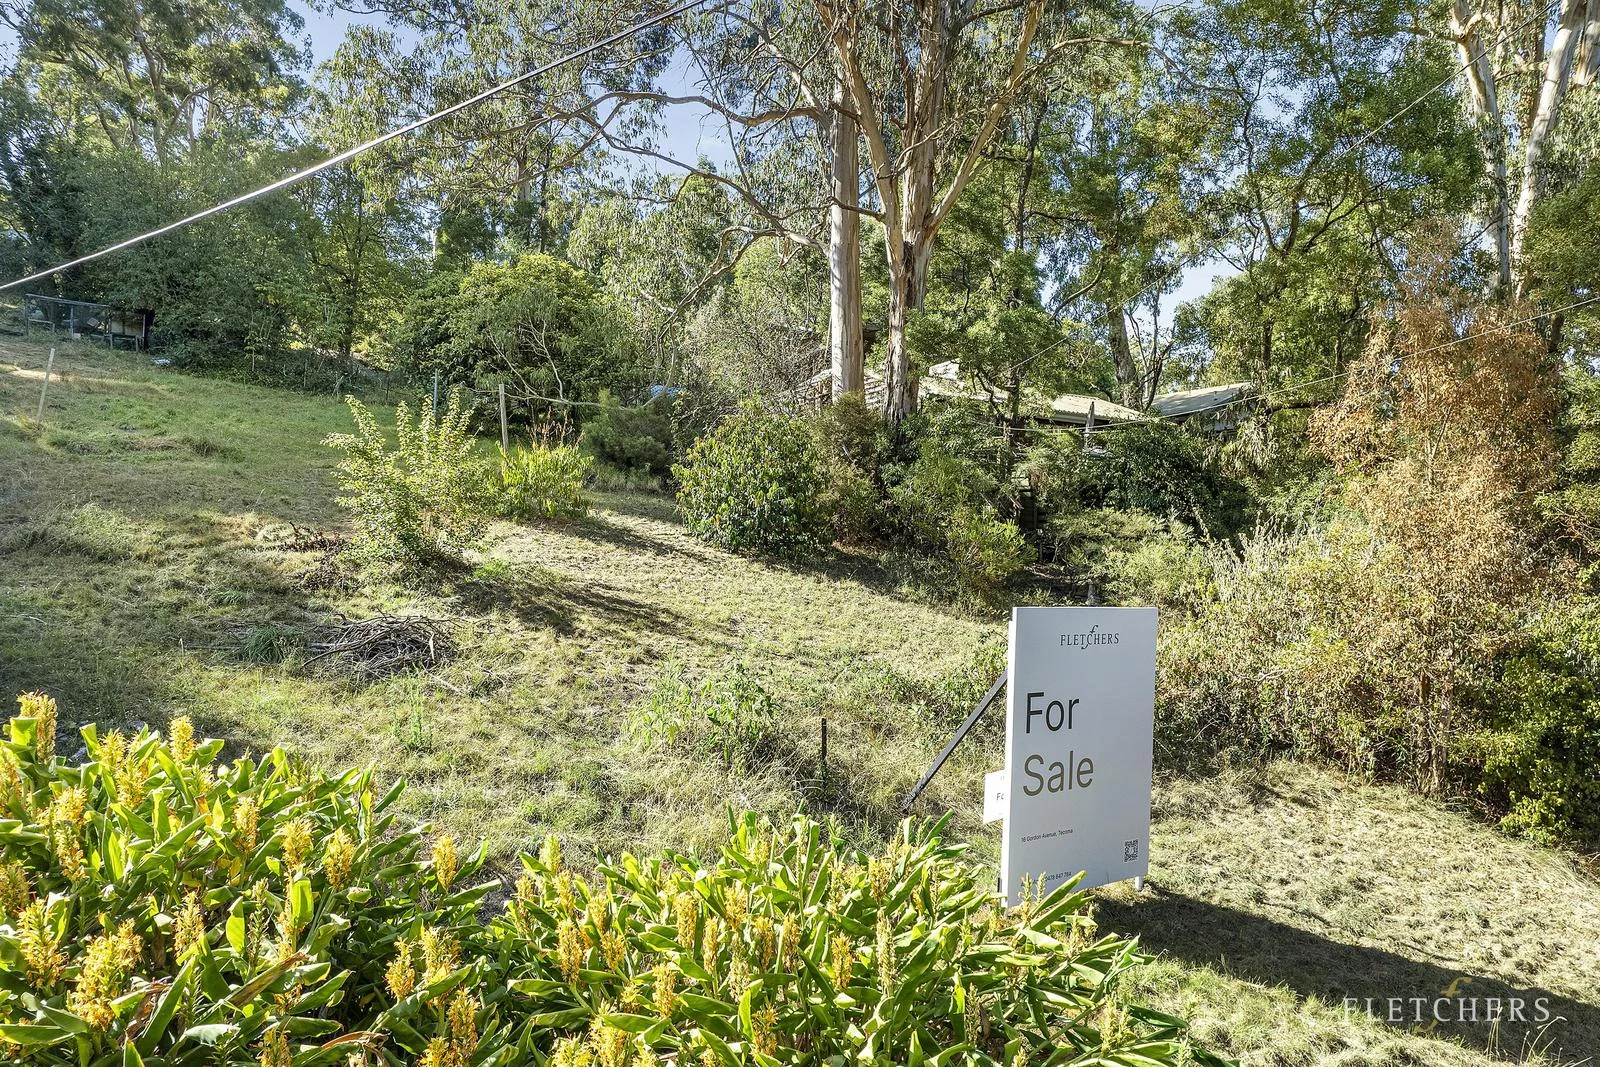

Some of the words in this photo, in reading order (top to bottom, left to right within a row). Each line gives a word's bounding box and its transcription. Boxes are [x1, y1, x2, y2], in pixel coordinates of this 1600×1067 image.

[1060, 632, 1120, 646] FLETCHERS
[1025, 691, 1080, 734] For
[1023, 750, 1094, 797] Sale
[1027, 834, 1041, 842] Gordon
